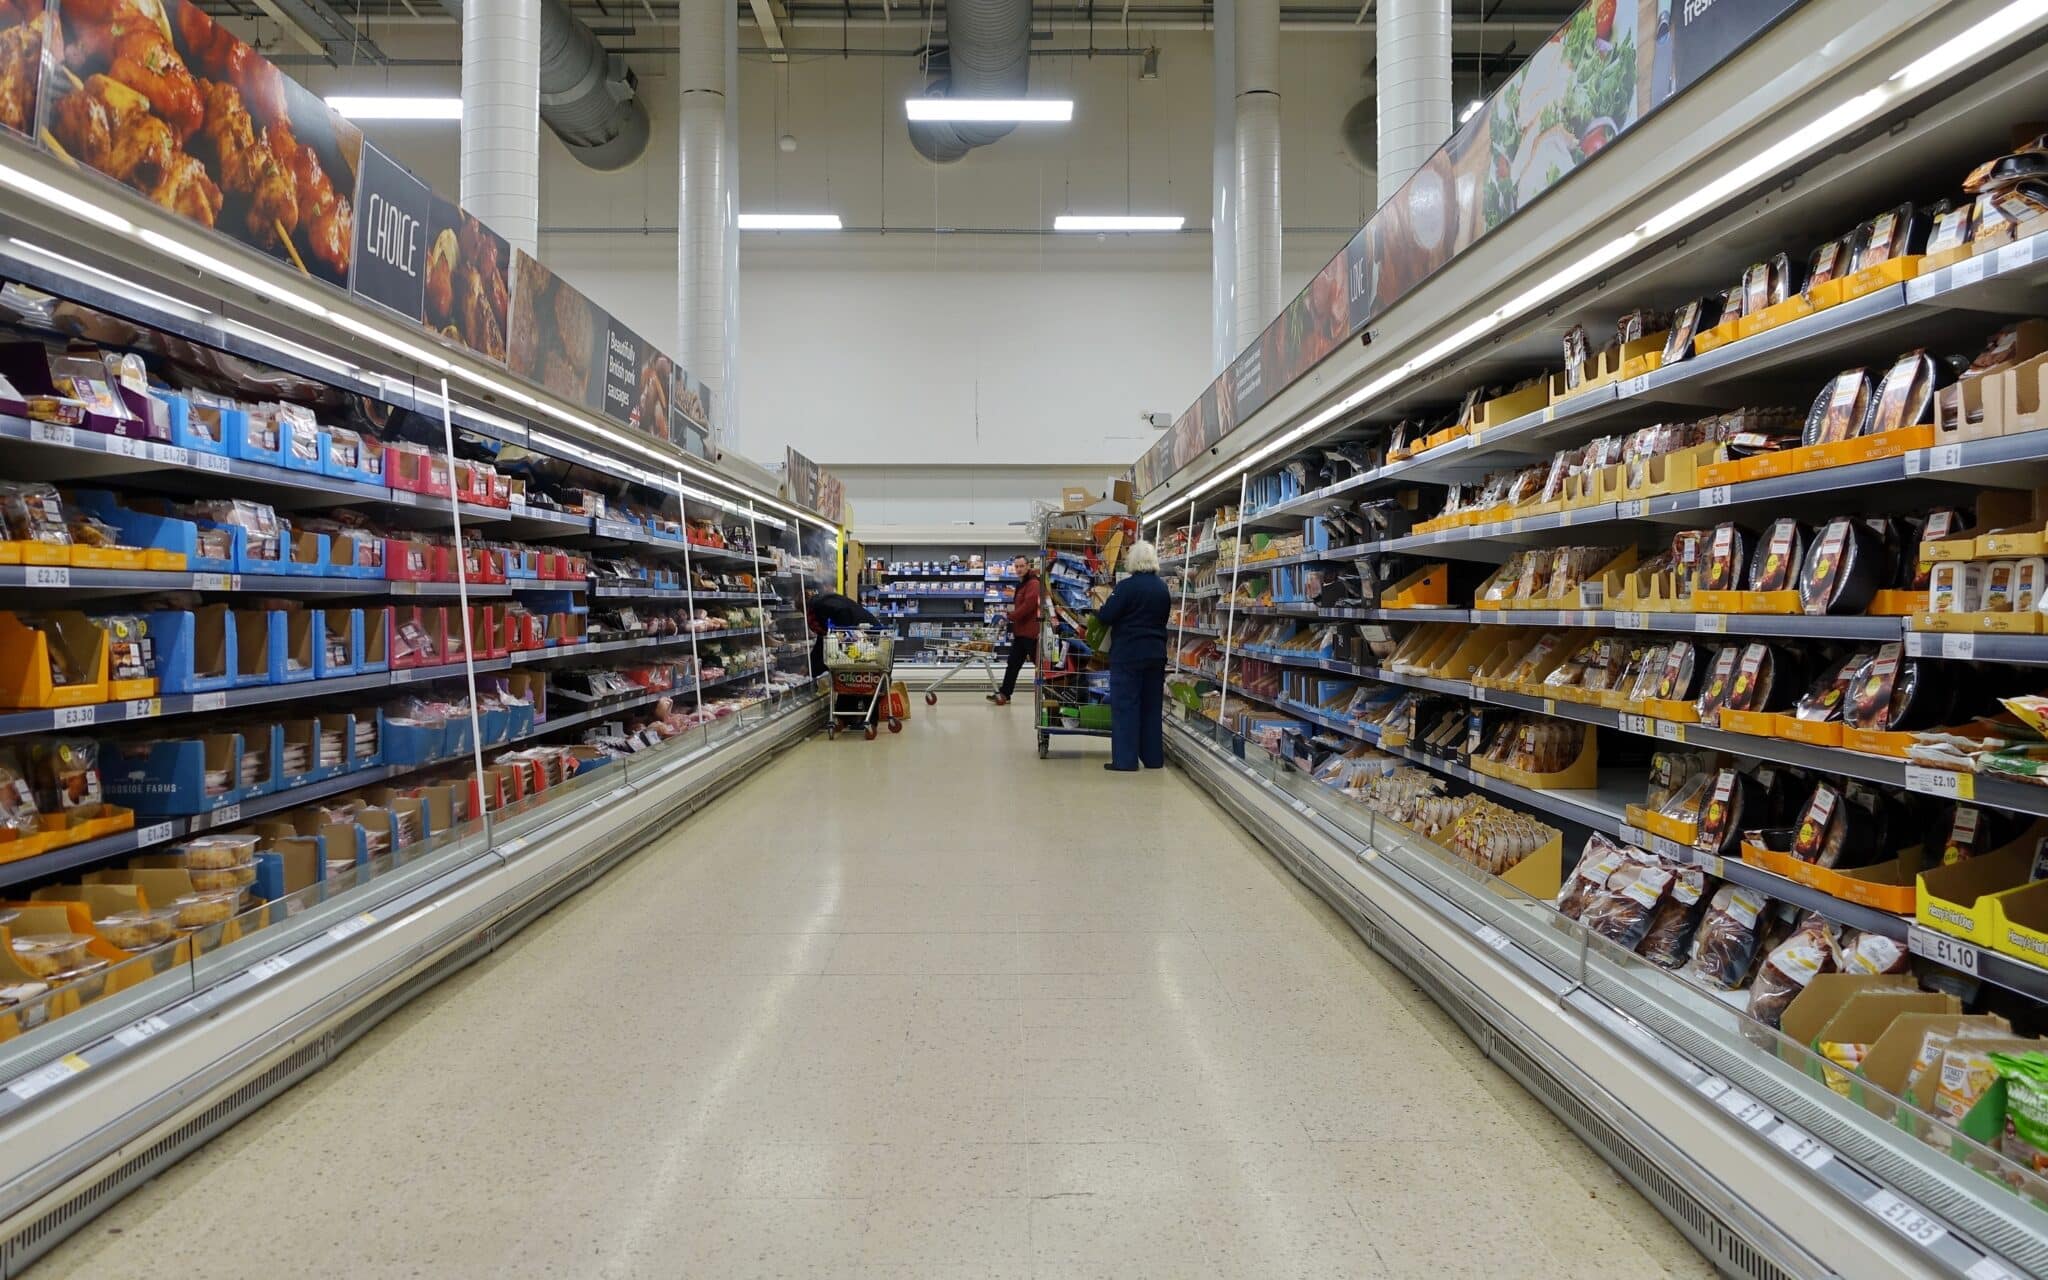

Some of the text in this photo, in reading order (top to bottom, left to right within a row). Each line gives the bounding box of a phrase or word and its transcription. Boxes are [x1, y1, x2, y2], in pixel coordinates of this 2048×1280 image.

[1684, 0, 1716, 27] fres
[367, 193, 420, 277] CHOICE
[608, 354, 636, 387] British pork
[607, 383, 630, 408] sausages
[43, 427, 72, 442] £2.75
[122, 441, 136, 455] £2
[1945, 449, 1959, 466] £1
[1712, 487, 1724, 505] £3
[38, 568, 66, 584] £2.75
[66, 707, 93, 724] £3.30
[137, 700, 150, 716] £2
[146, 783, 177, 794] FARMS
[1933, 775, 1956, 789] £2.10
[147, 823, 170, 843] £1.25
[1937, 941, 1973, 968] £1.10
[1737, 1103, 1765, 1122] £1
[1792, 1138, 1820, 1160] £1
[1884, 1202, 1938, 1240] £1.85
